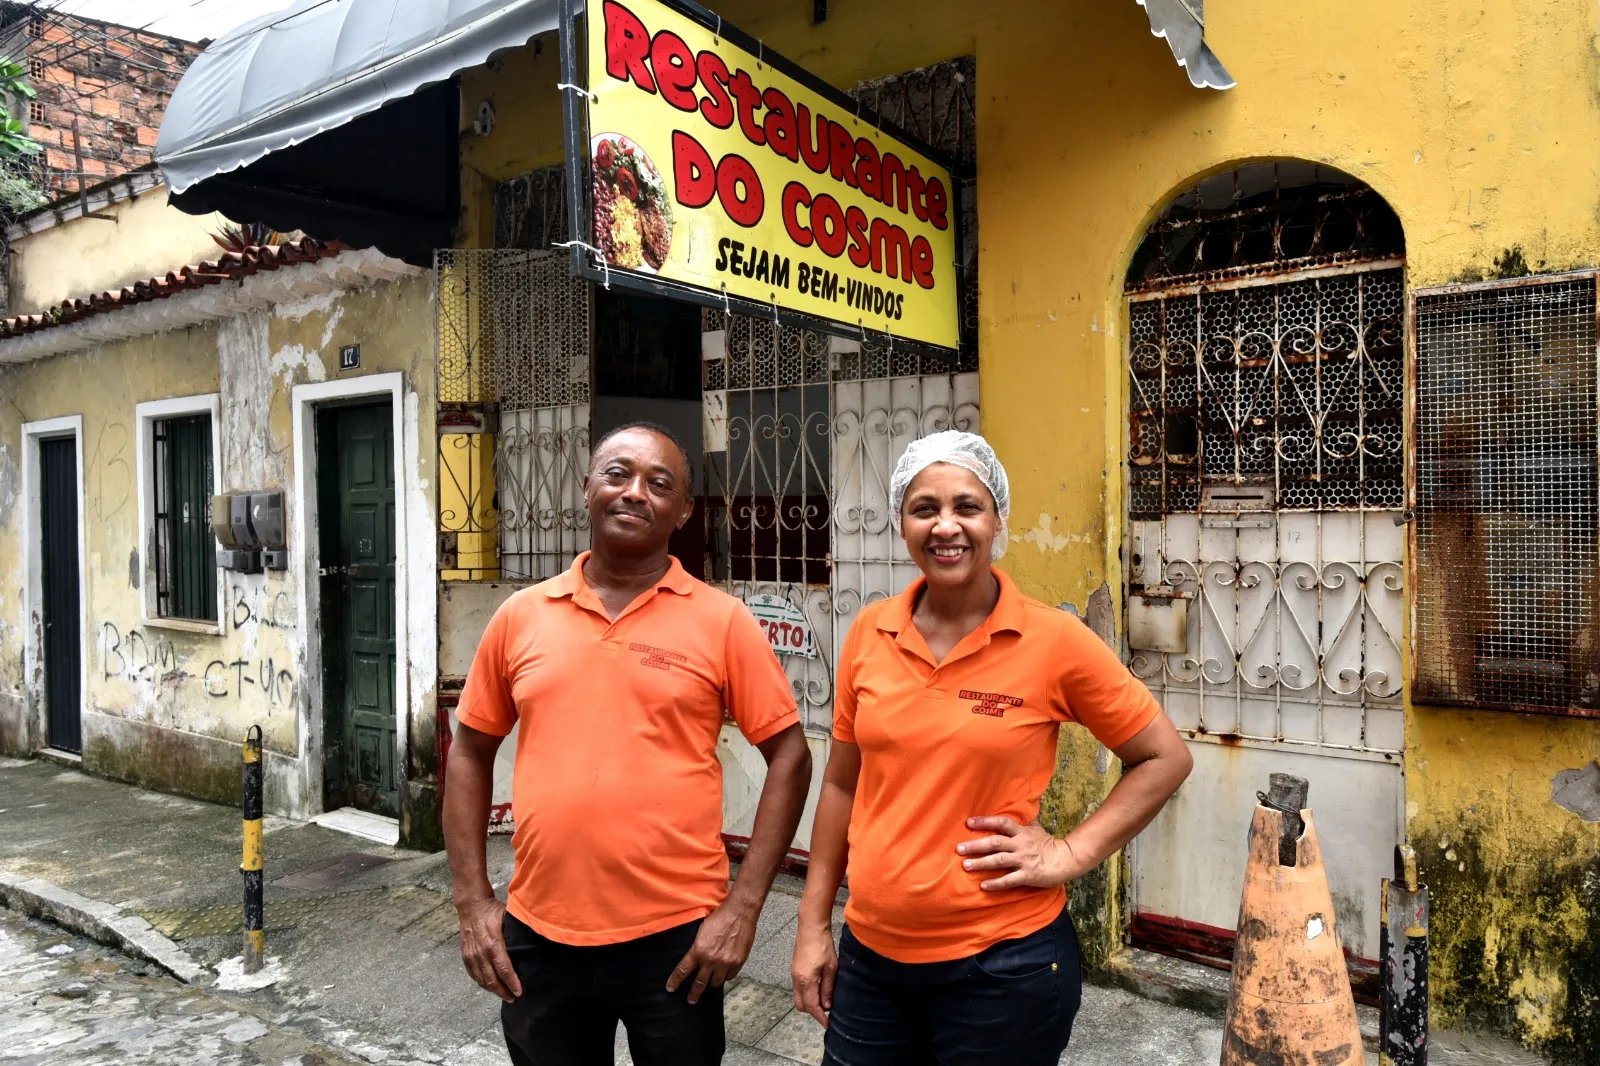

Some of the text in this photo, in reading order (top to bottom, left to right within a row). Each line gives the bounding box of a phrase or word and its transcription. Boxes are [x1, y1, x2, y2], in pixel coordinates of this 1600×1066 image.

[671, 129, 765, 228] DO
[716, 237, 904, 321] SEJAM BEM-VINDOS
[344, 347, 354, 366] 17
[959, 690, 1023, 707] RESTAURANTE
[981, 700, 997, 709] DO
[972, 705, 1004, 717] COSME
